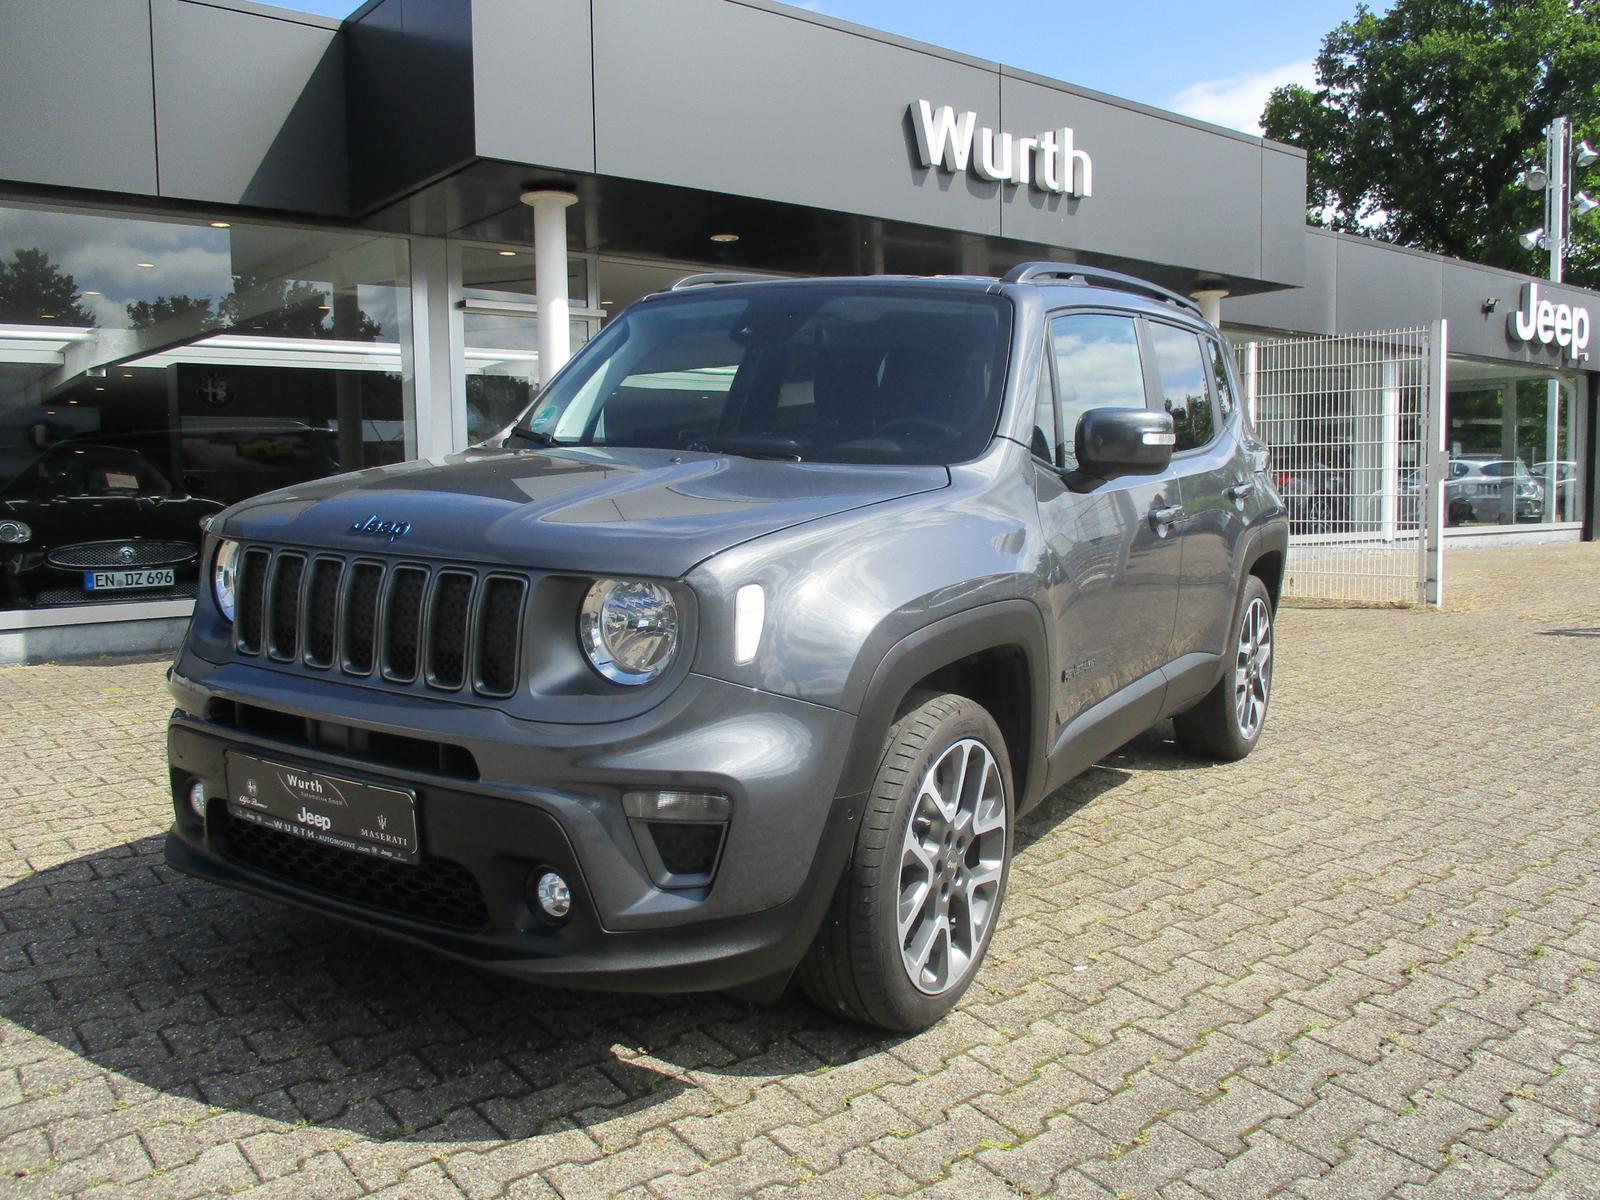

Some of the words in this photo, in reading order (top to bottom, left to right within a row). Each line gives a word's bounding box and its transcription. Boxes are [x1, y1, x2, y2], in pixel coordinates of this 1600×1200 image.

[909, 99, 1092, 197] Wurth
[1510, 282, 1590, 360] Jeep
[351, 514, 411, 542] Jeep
[95, 574, 115, 587] EN
[125, 573, 143, 586] DZ
[146, 571, 173, 584] 696
[286, 773, 323, 794] Wurth
[297, 806, 332, 831] Jeep
[360, 828, 408, 846] MASERATI
